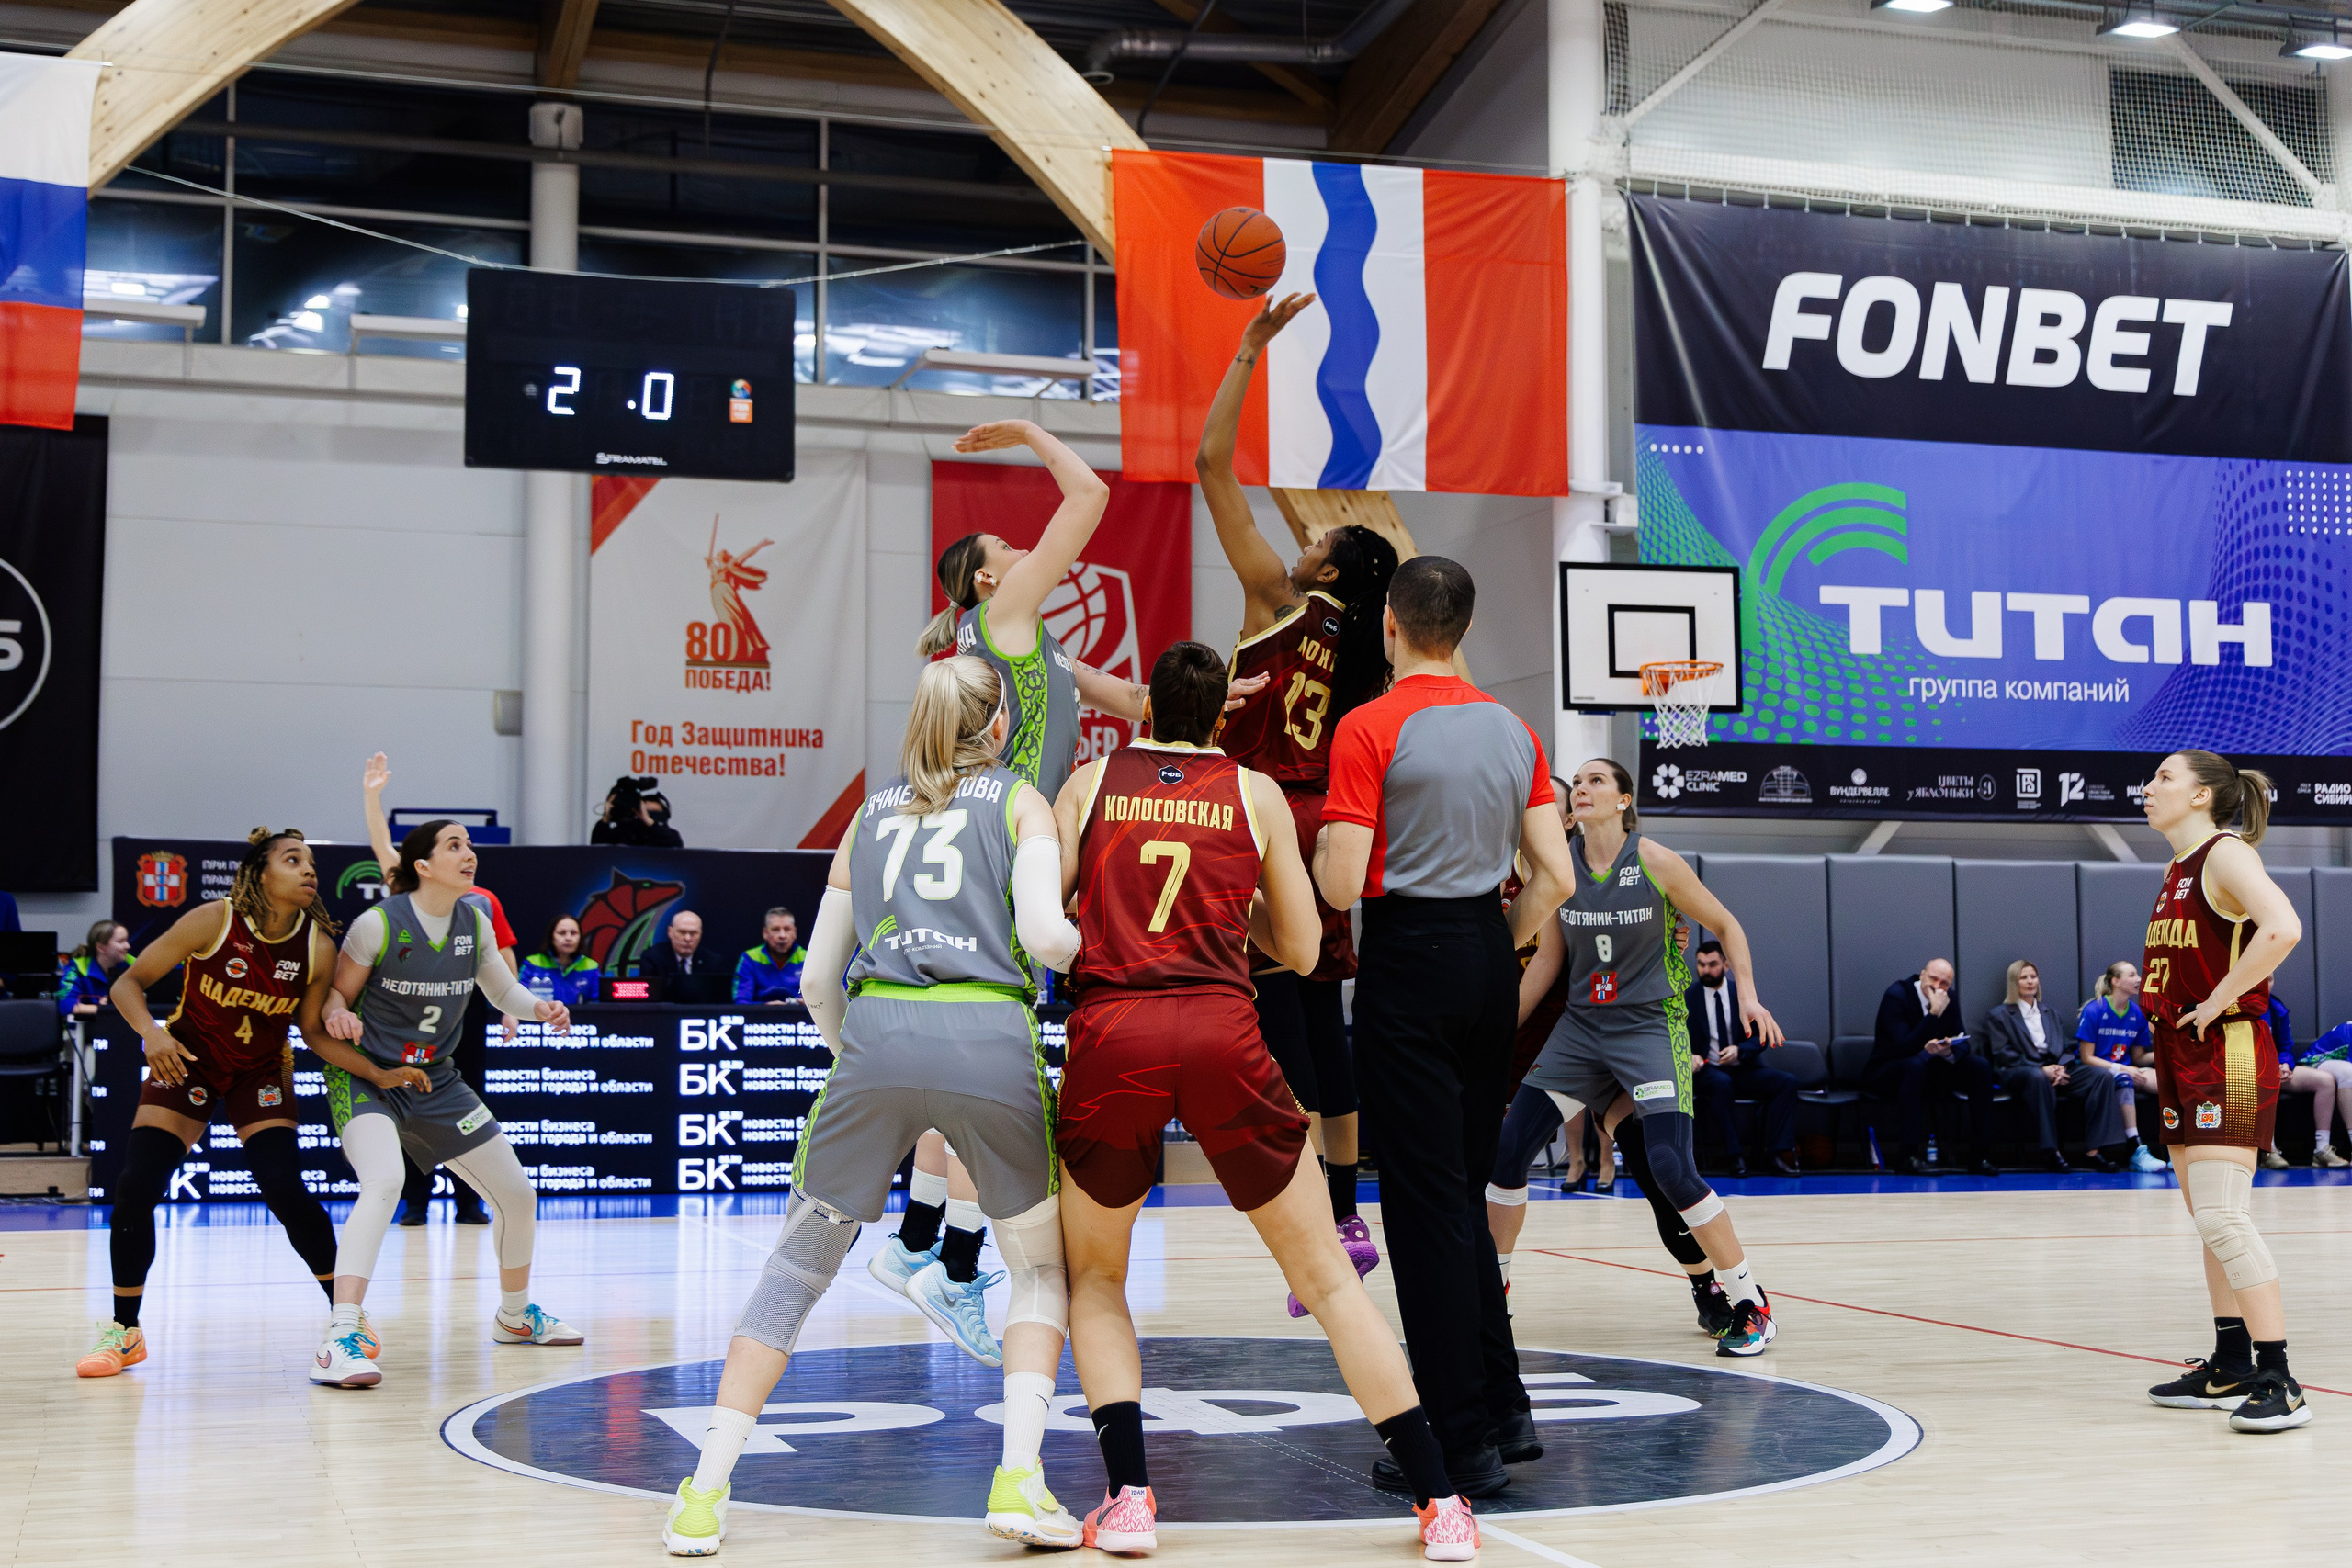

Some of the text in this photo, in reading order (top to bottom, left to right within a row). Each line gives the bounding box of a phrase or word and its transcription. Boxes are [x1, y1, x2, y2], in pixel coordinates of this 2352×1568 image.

[1762, 272, 2233, 397] FONBET
[548, 367, 581, 415] 2
[685, 621, 733, 661] 80
[685, 669, 771, 694] ПОБЕДА!
[1909, 677, 2130, 704] группа компаний
[1284, 671, 1331, 750] 13
[631, 720, 824, 750] Год Защитника
[631, 750, 786, 777] Отечества!
[1686, 770, 1747, 783] EZRAMED
[1686, 782, 1720, 793] CLINIC
[2058, 772, 2085, 807] 12
[2314, 783, 2351, 794] РАДИО
[1104, 795, 1234, 831] КОЛОСОВСКАЯ
[876, 809, 967, 903] 73
[1619, 865, 1640, 877] FON
[1139, 840, 1191, 932] 7
[1619, 874, 1641, 886] BET
[2177, 877, 2193, 889] FON
[2173, 889, 2189, 900] BET
[1559, 907, 1653, 926] НЕФТЯНИК-ТИТАН
[454, 935, 473, 946] FON
[454, 945, 474, 956] BET
[1595, 934, 1612, 963] 8
[276, 960, 301, 972] FON
[273, 970, 299, 982] BET
[2143, 958, 2170, 993] 27
[199, 973, 300, 1017] НАДЕЖДА
[418, 1005, 442, 1034] 2
[234, 1015, 254, 1044] 4
[743, 1023, 796, 1034] новости
[601, 1033, 654, 1048] области
[743, 1036, 796, 1046] новости
[485, 1069, 540, 1080] новости
[742, 1068, 795, 1079] новости
[485, 1082, 540, 1093] новости
[600, 1079, 654, 1093] области
[742, 1080, 795, 1091] новости
[741, 1118, 795, 1130] новости
[599, 1130, 653, 1145] области
[741, 1131, 795, 1142] новости
[598, 1175, 652, 1189] области
